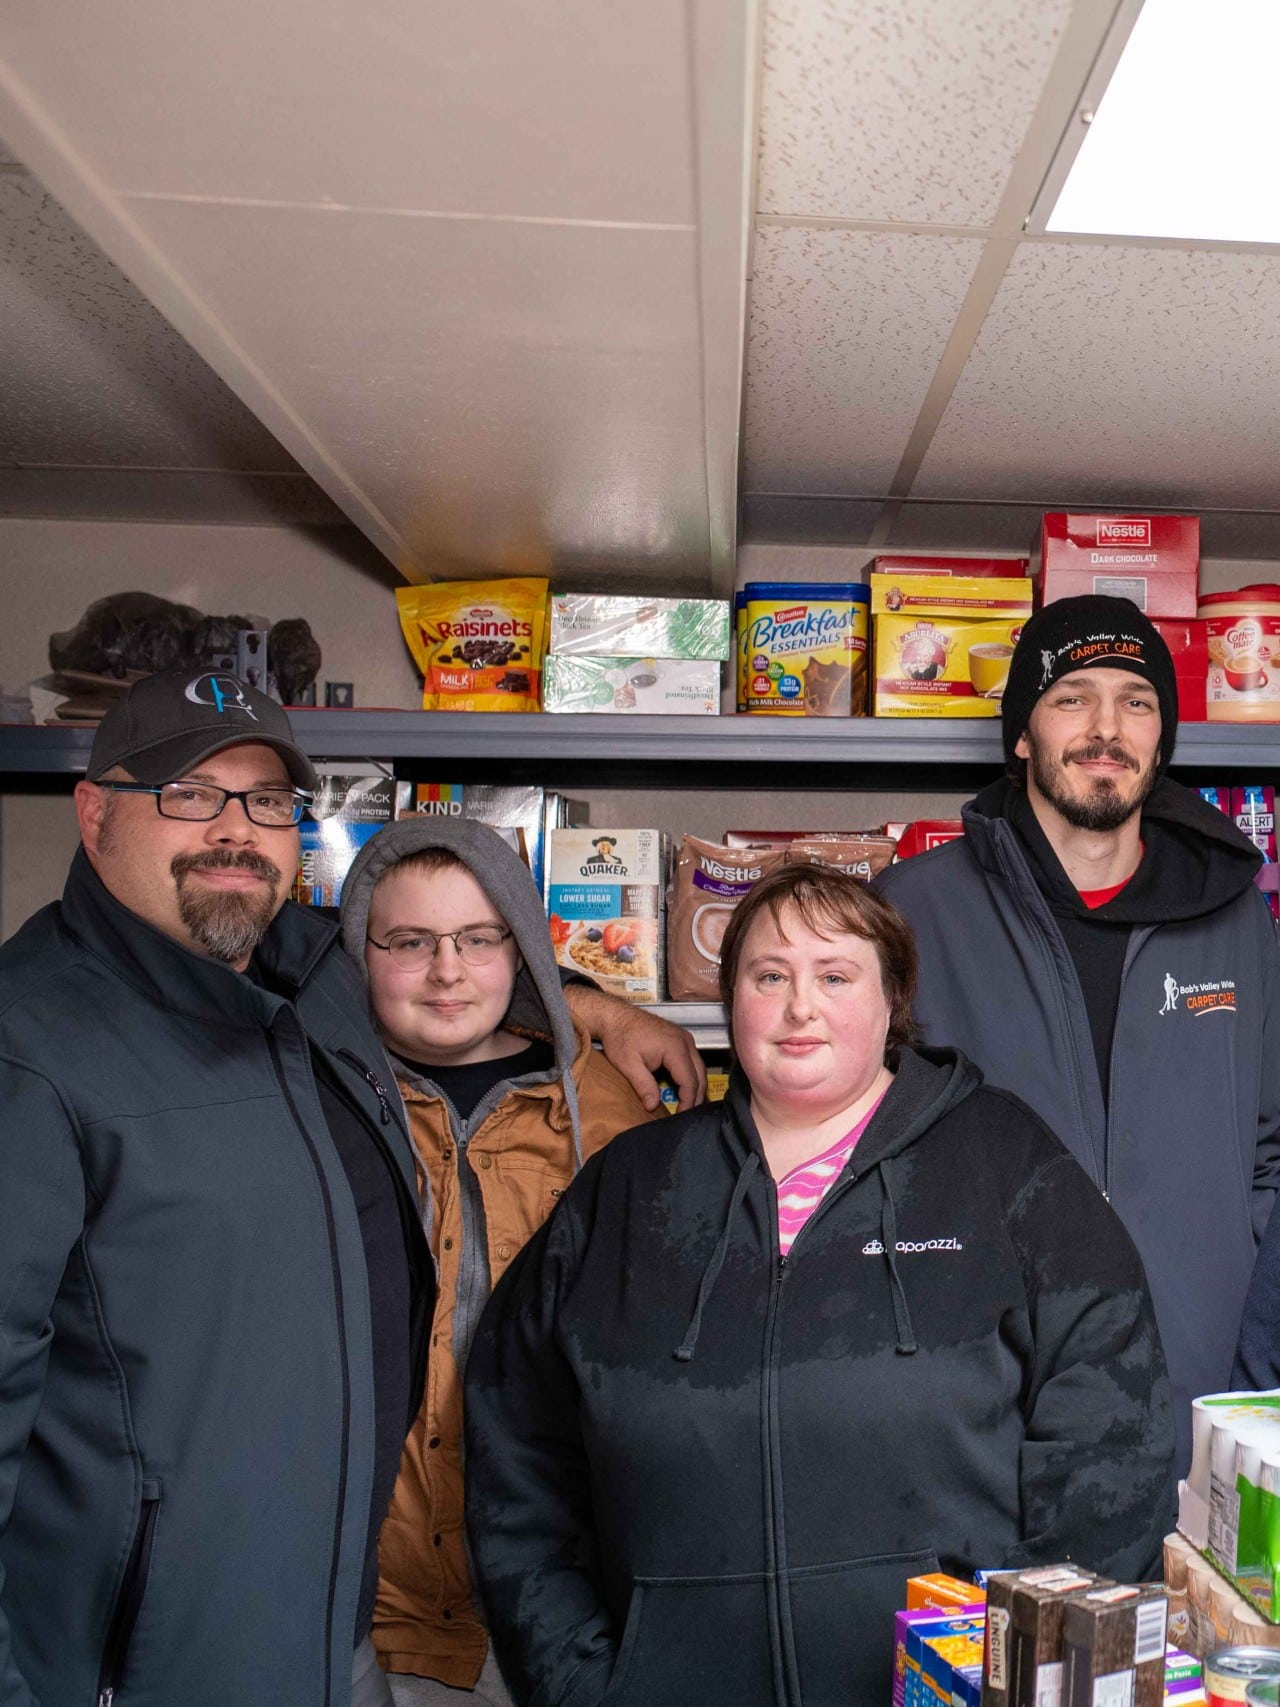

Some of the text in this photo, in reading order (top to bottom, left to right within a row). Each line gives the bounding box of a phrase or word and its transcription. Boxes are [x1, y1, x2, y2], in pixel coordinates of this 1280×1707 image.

[437, 618, 532, 639] Raisinets
[748, 607, 861, 648] Breakfast
[770, 633, 841, 654] ESSENTIALS
[904, 630, 945, 643] ABUELITA
[1086, 633, 1116, 642] Valley
[1227, 629, 1256, 645] Coffee
[1070, 642, 1141, 662] CARPET CARE
[440, 672, 469, 685] MILK
[774, 698, 804, 706] Chocolate
[361, 793, 390, 804] PACK
[361, 808, 390, 817] PROTEIN
[416, 801, 463, 816] KIND
[1239, 816, 1271, 827] ALERT
[302, 851, 315, 886] KIND
[579, 864, 629, 877] QUAKER
[559, 894, 611, 904] LOWER SUGAR
[1180, 980, 1236, 995] Bob's Valley Wide
[1186, 992, 1236, 1009] CARPET CARE
[989, 1612, 1001, 1683] LINGUINE
